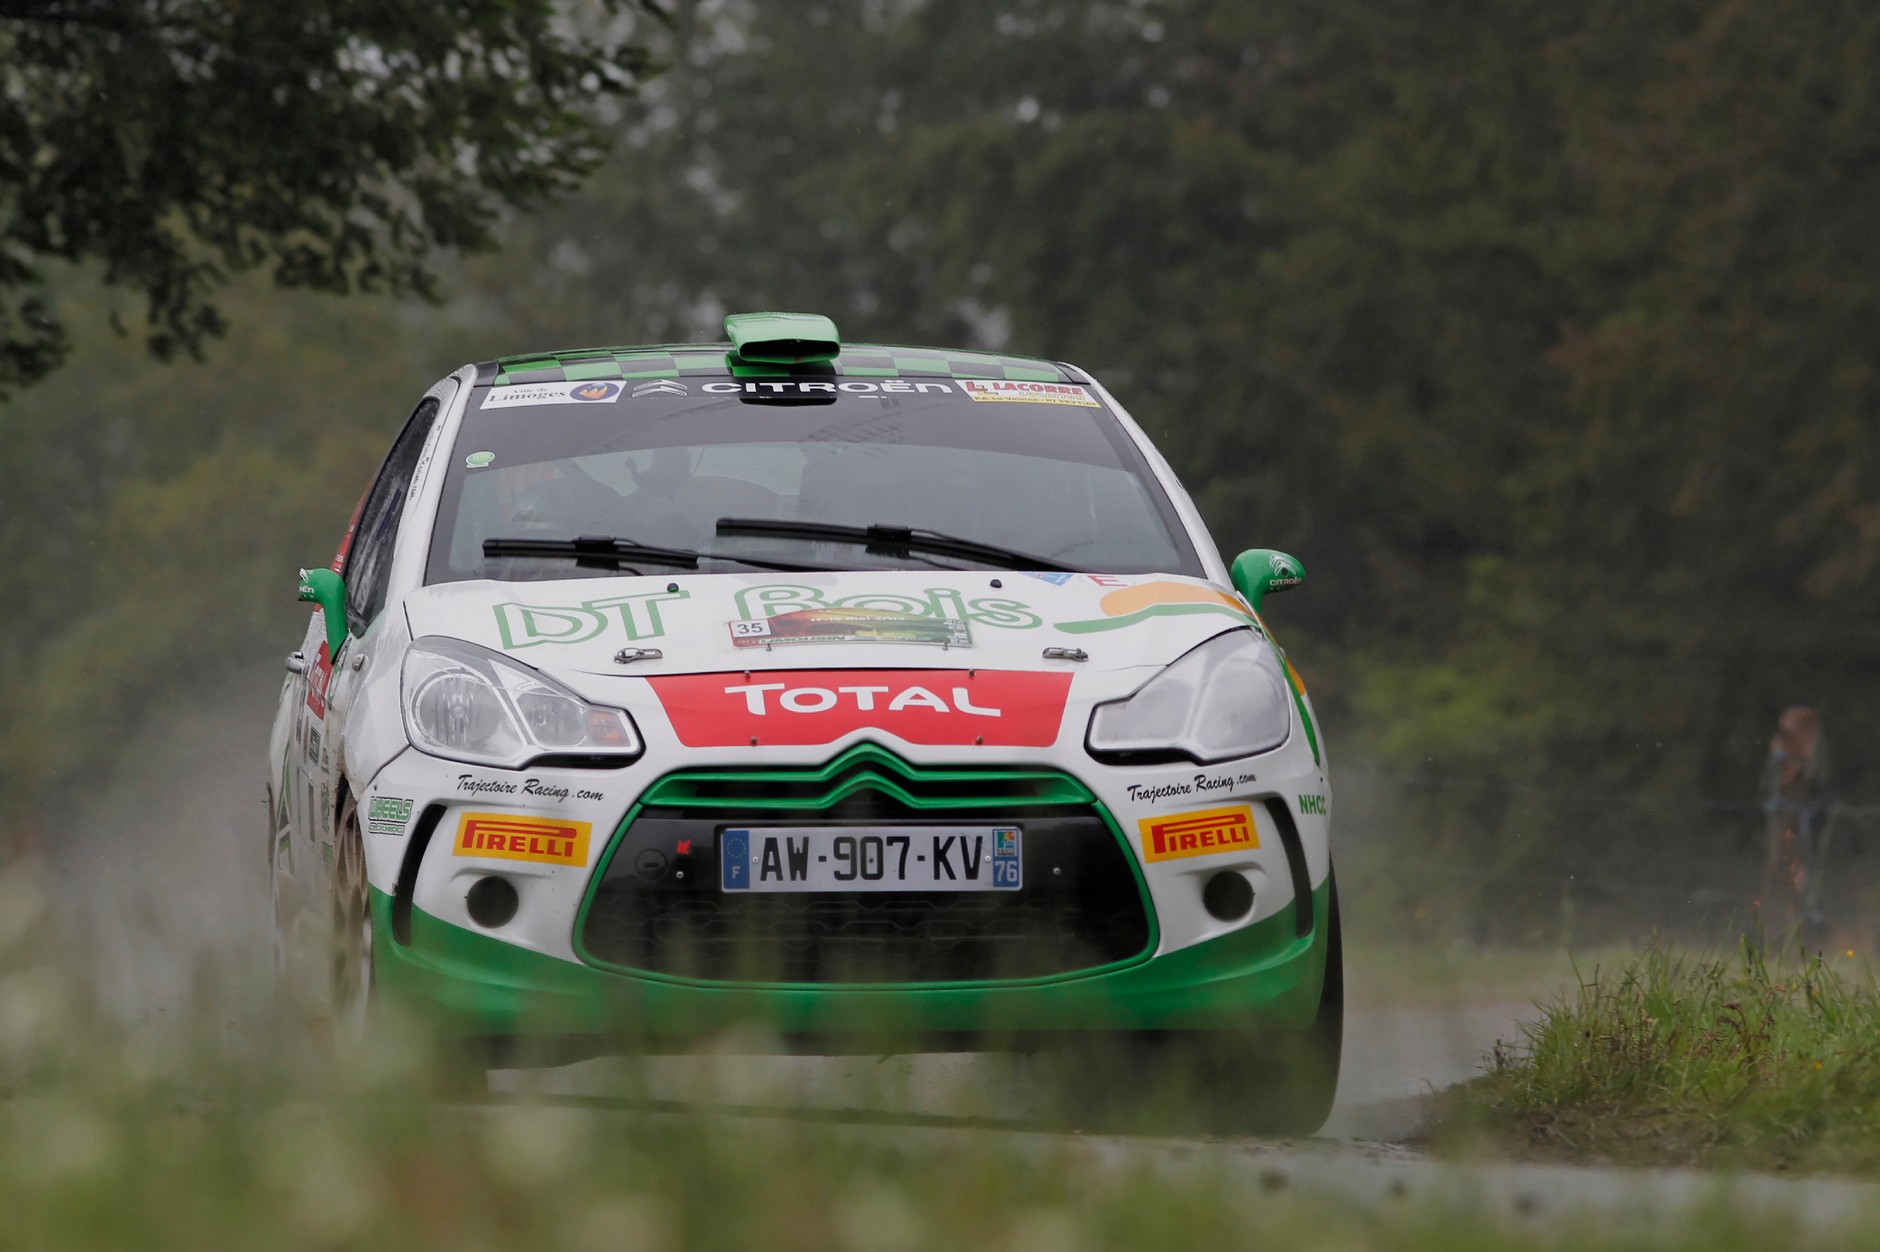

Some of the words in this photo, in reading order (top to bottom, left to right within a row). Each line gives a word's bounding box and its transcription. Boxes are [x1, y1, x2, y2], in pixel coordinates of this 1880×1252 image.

[488, 390, 567, 402] Limoges
[992, 382, 1082, 395] LACORRE
[492, 590, 691, 650] DT
[736, 622, 763, 635] 35
[724, 683, 1001, 717] TOTAL
[456, 774, 517, 796] Trajectoire
[1127, 784, 1192, 804] Trajectoire
[462, 819, 578, 858] PIRELLI
[1151, 813, 1250, 854] PIRELLI
[759, 836, 984, 881] AW-907-KV
[731, 865, 741, 879] F
[994, 860, 1018, 882] 76
